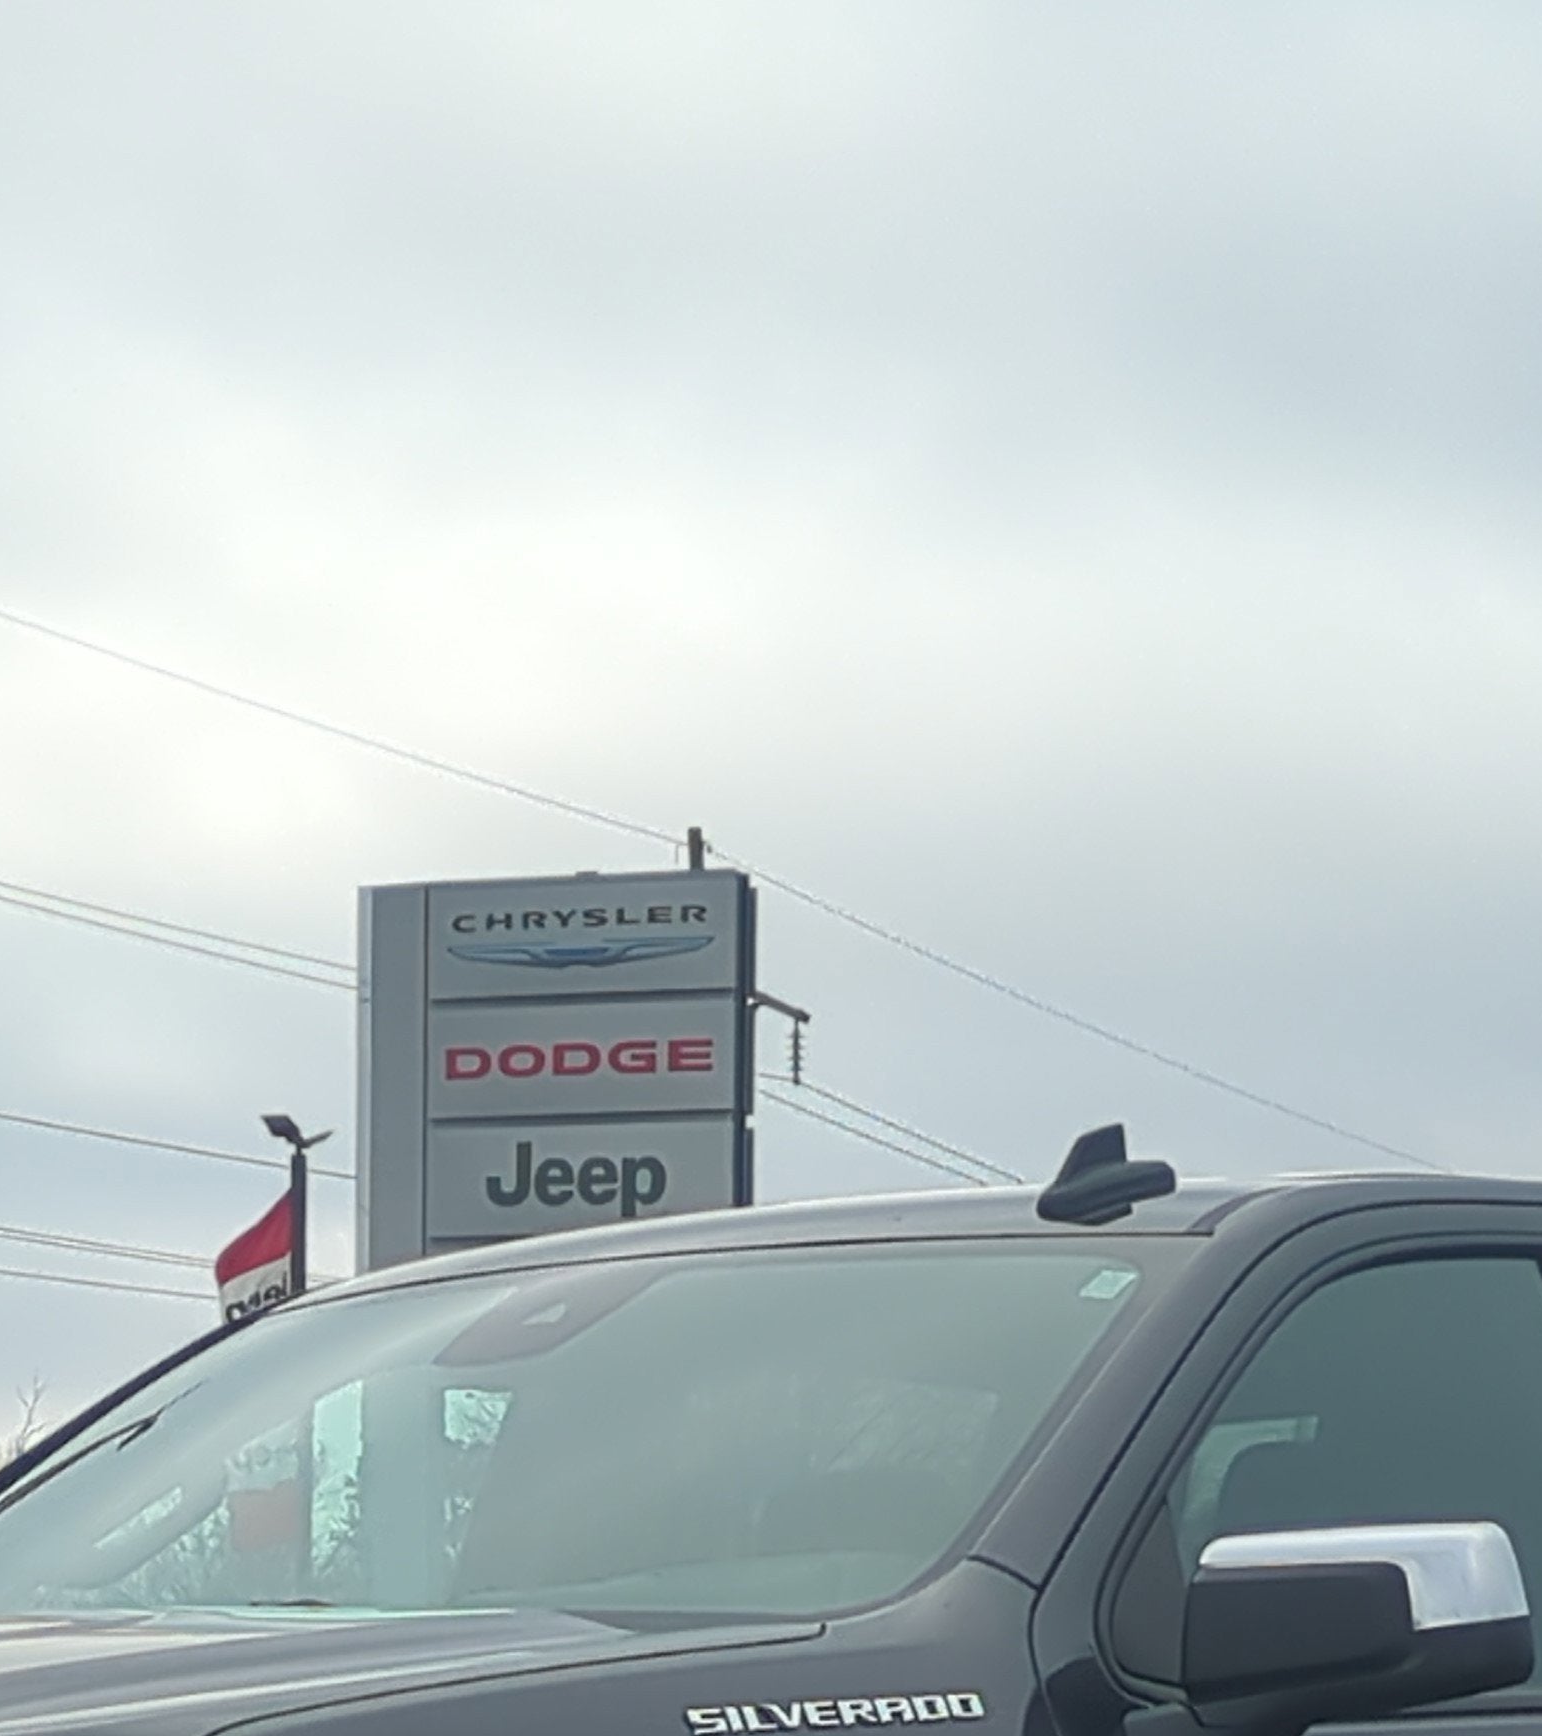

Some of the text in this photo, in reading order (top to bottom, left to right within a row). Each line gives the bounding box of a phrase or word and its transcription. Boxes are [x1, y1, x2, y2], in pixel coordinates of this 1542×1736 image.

[451, 903, 709, 934] CHRYSLER
[444, 1037, 714, 1081] DODGE
[485, 1141, 666, 1217] Jeep
[685, 1692, 986, 1736] SILVERADO
